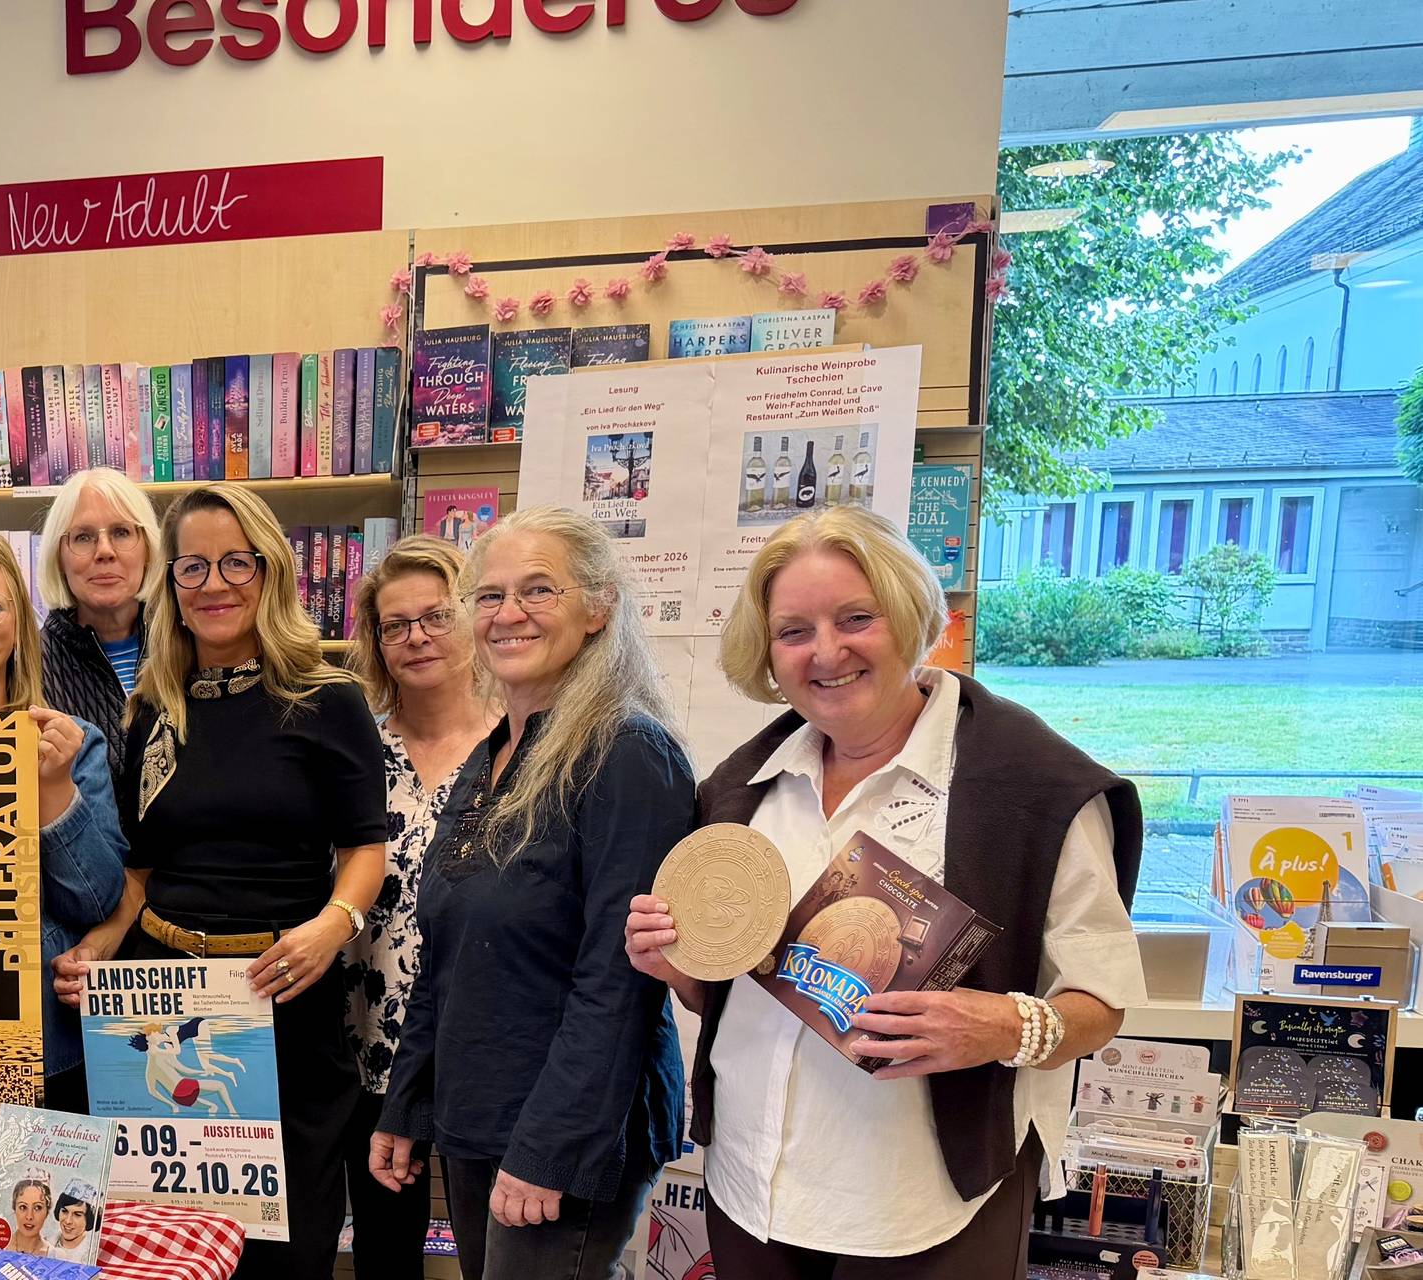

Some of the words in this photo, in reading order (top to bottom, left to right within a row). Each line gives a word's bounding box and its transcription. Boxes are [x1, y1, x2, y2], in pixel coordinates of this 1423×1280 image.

[66, 0, 799, 75] Besone
[8, 191, 101, 250] New
[105, 172, 248, 244] Adult
[675, 322, 714, 331] CHRISTINA
[717, 320, 747, 328] KASPAR
[757, 315, 799, 324] CHRISTINA
[802, 313, 832, 321] KASPAR
[424, 338, 442, 347] JULIA
[445, 334, 482, 345] HAUSBURG
[504, 338, 523, 347] JULIA
[526, 335, 565, 345] HAUSBURG
[581, 335, 600, 343] JULIA
[602, 333, 642, 342] HAUSBURG
[673, 334, 748, 347] HARPERS
[766, 328, 823, 341] SILVER
[279, 362, 288, 385] Trust
[427, 356, 487, 376] Fighting
[756, 362, 819, 376] Kulinarische
[821, 358, 877, 370] Weinprobe
[419, 371, 484, 388] THROUGH
[786, 373, 844, 385] Tschechien
[104, 369, 112, 420] SCHWEIGEN
[156, 373, 167, 412] UNLOVED
[430, 388, 466, 405] Deep
[609, 385, 639, 396] Lesung
[746, 394, 762, 402] von
[764, 390, 808, 401] Friedhelm
[810, 387, 845, 398] Conrad,
[847, 386, 858, 394] La
[860, 384, 883, 394] Cave
[279, 387, 289, 424] Building
[425, 401, 475, 417] WATERS
[598, 405, 614, 415] Lied
[615, 404, 626, 413] für
[628, 403, 643, 412] den
[765, 397, 841, 411] Wein-Fachhandel
[843, 396, 861, 405] und
[746, 411, 794, 422] Restaurant
[821, 406, 854, 417] Weißen
[600, 423, 611, 431] Iva
[612, 419, 657, 430] Procházková
[591, 444, 602, 454] Iva
[920, 476, 966, 487] KENNEDY
[428, 493, 457, 502] FELICIA
[458, 492, 494, 501] KINGSLEY
[608, 500, 624, 509] Lied
[591, 508, 611, 520] den
[614, 507, 639, 520] Weg
[917, 502, 940, 512] THE
[909, 511, 950, 526] GOAL
[312, 546, 323, 583] FORGETTING
[331, 548, 341, 578] TRUSTING
[664, 552, 689, 562] 2026
[1341, 831, 1353, 851] 1
[1280, 852, 1330, 877] plus!
[887, 869, 912, 892] Czech
[909, 885, 926, 900] spa
[878, 878, 919, 910] CHOCOLATE
[87, 967, 208, 991] LANDSCHAFT
[229, 969, 245, 979] Filip
[783, 949, 867, 1013] KOLONÁDA
[1300, 969, 1374, 982] Ravensburger
[89, 994, 124, 1015] DER
[132, 993, 185, 1015] LIEBE
[1279, 1020, 1312, 1036] Basically
[31, 1124, 47, 1136] Drei
[51, 1121, 101, 1142] Haselnüsse
[203, 1125, 274, 1140] AUSSTELLUNG
[40, 1134, 53, 1148] für
[24, 1149, 83, 1169] Aschenbrödel
[1391, 1156, 1423, 1167] CHAK
[150, 1160, 279, 1197] 22.10.26
